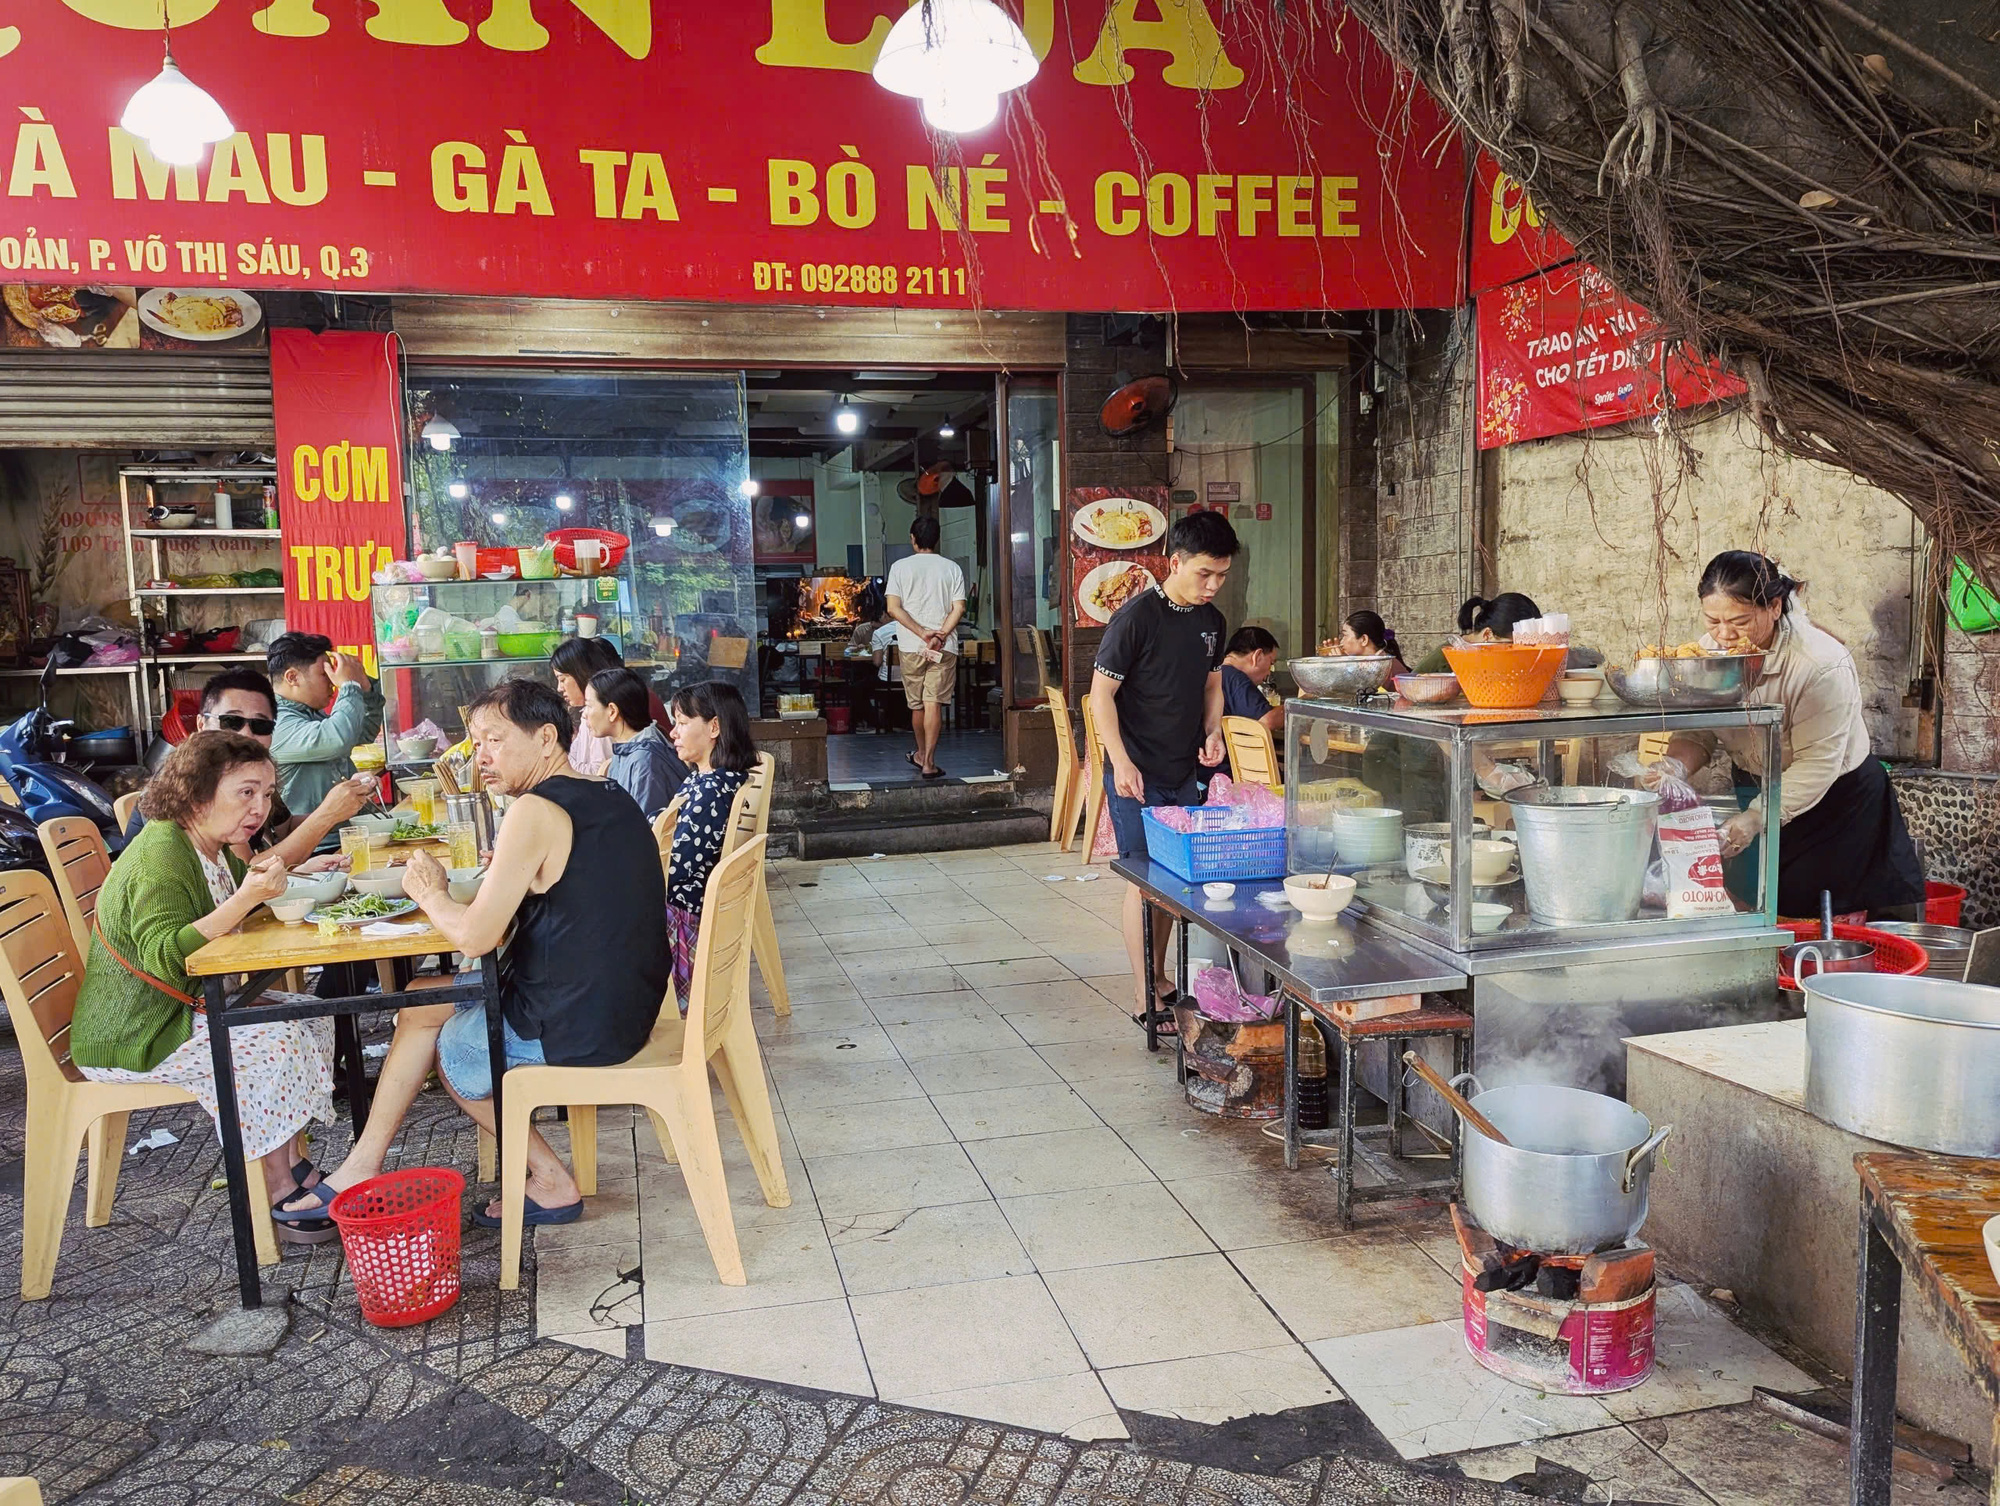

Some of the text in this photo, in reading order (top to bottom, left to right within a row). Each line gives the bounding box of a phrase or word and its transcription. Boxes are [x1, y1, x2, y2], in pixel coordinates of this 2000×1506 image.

[430, 129, 555, 217] GÀ
[579, 149, 680, 222] TA
[768, 144, 877, 229] BÒ
[906, 153, 1011, 233] NÉ
[1094, 171, 1361, 238] COFFEE
[88, 238, 117, 271] P.
[123, 233, 169, 273] VÕ
[174, 240, 228, 281] THỊ
[236, 236, 311, 280] SÁU,
[319, 245, 373, 278] Q.3
[752, 261, 966, 295] ĐT: 092888 2111
[1527, 331, 1572, 359] TRAO
[1535, 362, 1571, 388] CHO
[1575, 347, 1610, 379] TẾT
[1594, 390, 1615, 406] Sprite
[293, 440, 391, 503] CƠM
